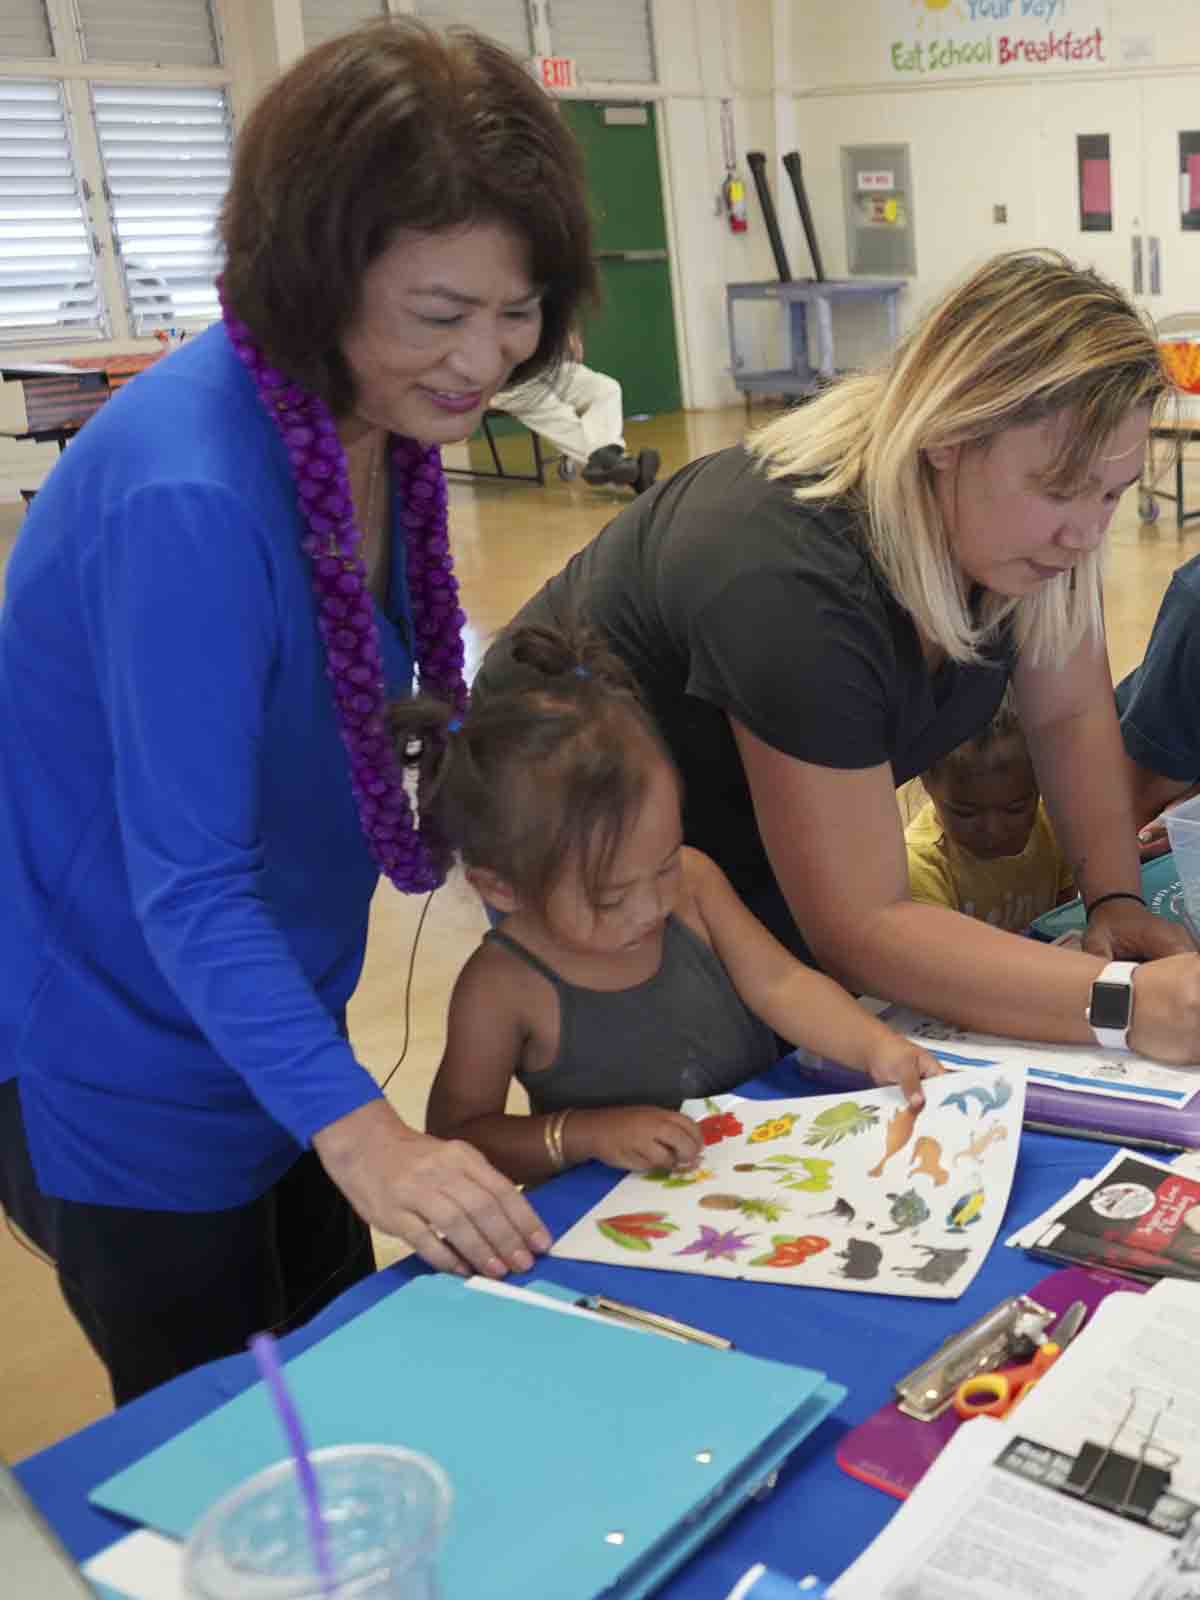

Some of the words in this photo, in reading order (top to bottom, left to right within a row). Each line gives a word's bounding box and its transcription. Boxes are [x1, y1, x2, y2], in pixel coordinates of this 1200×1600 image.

[891, 40, 925, 72] Eat
[928, 35, 992, 69] School
[997, 27, 1105, 65] Breakfast
[543, 57, 571, 88] EXIT
